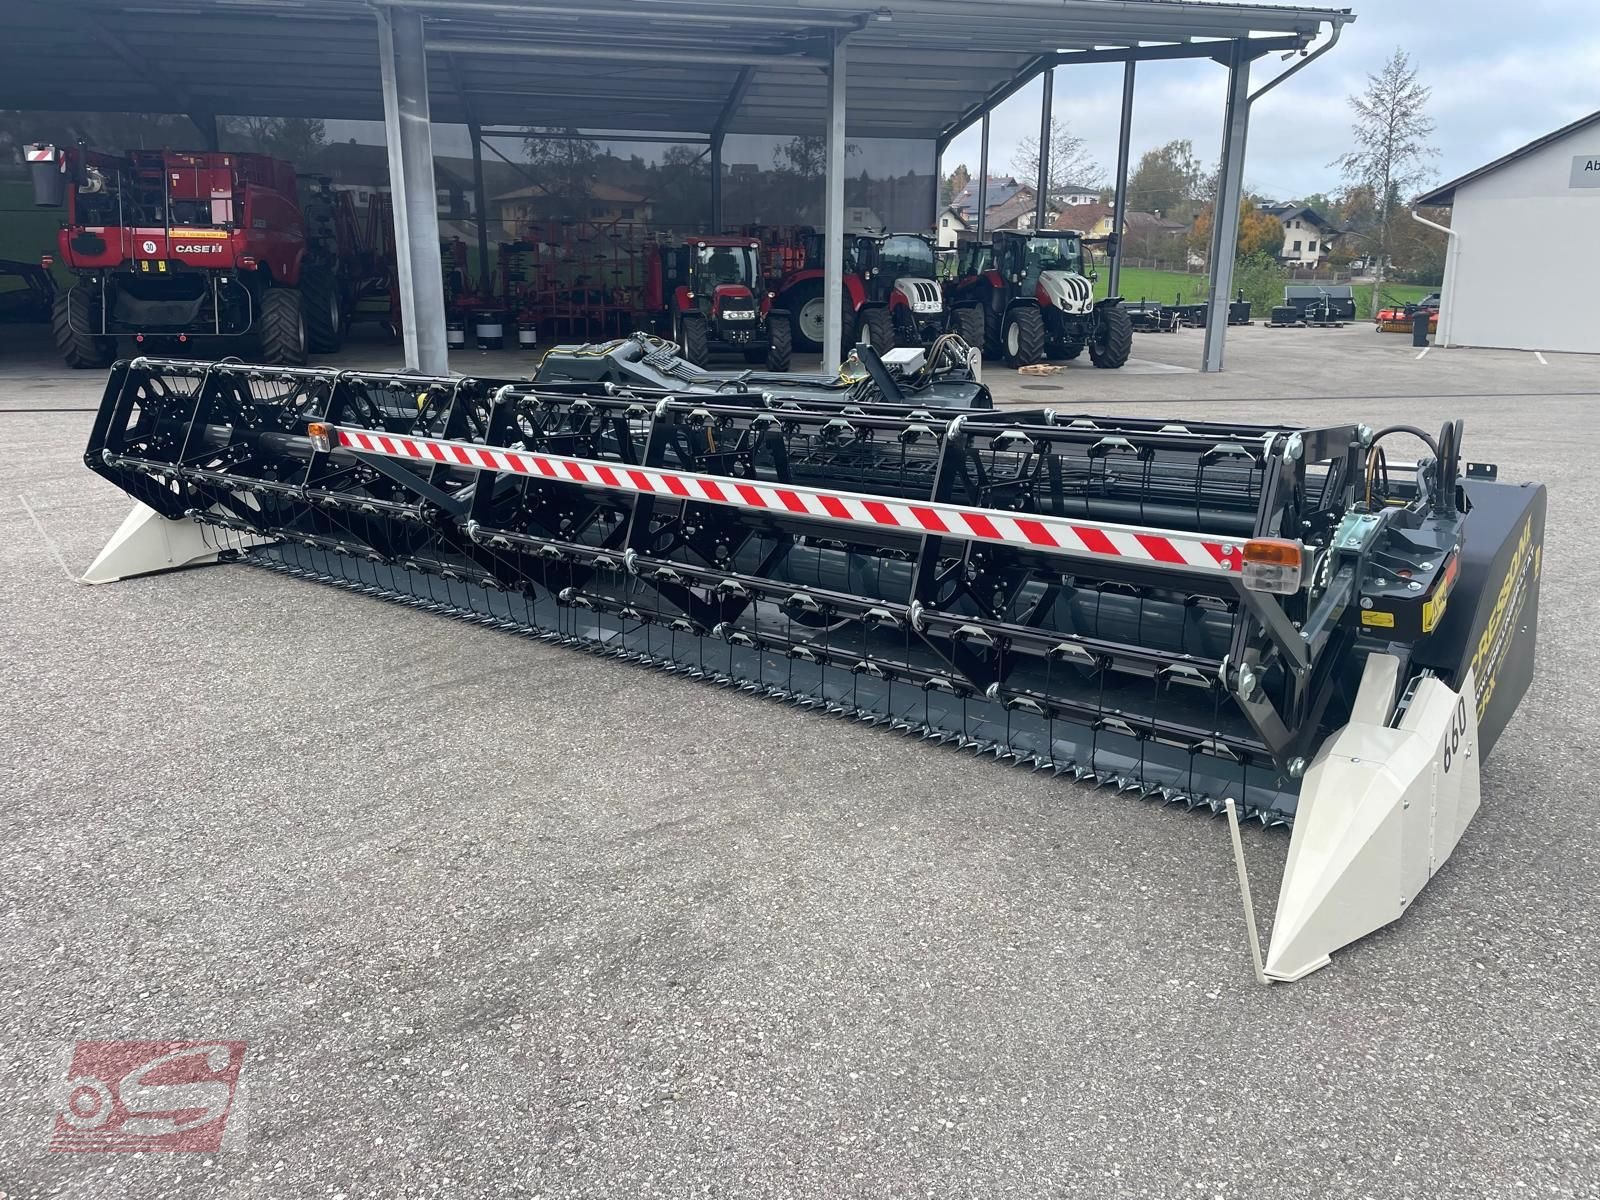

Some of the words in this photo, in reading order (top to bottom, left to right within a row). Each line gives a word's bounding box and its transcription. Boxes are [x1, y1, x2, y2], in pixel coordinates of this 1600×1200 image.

[145, 243, 154, 252] 30
[175, 245, 210, 253] CASE
[1444, 696, 1466, 774] 660
